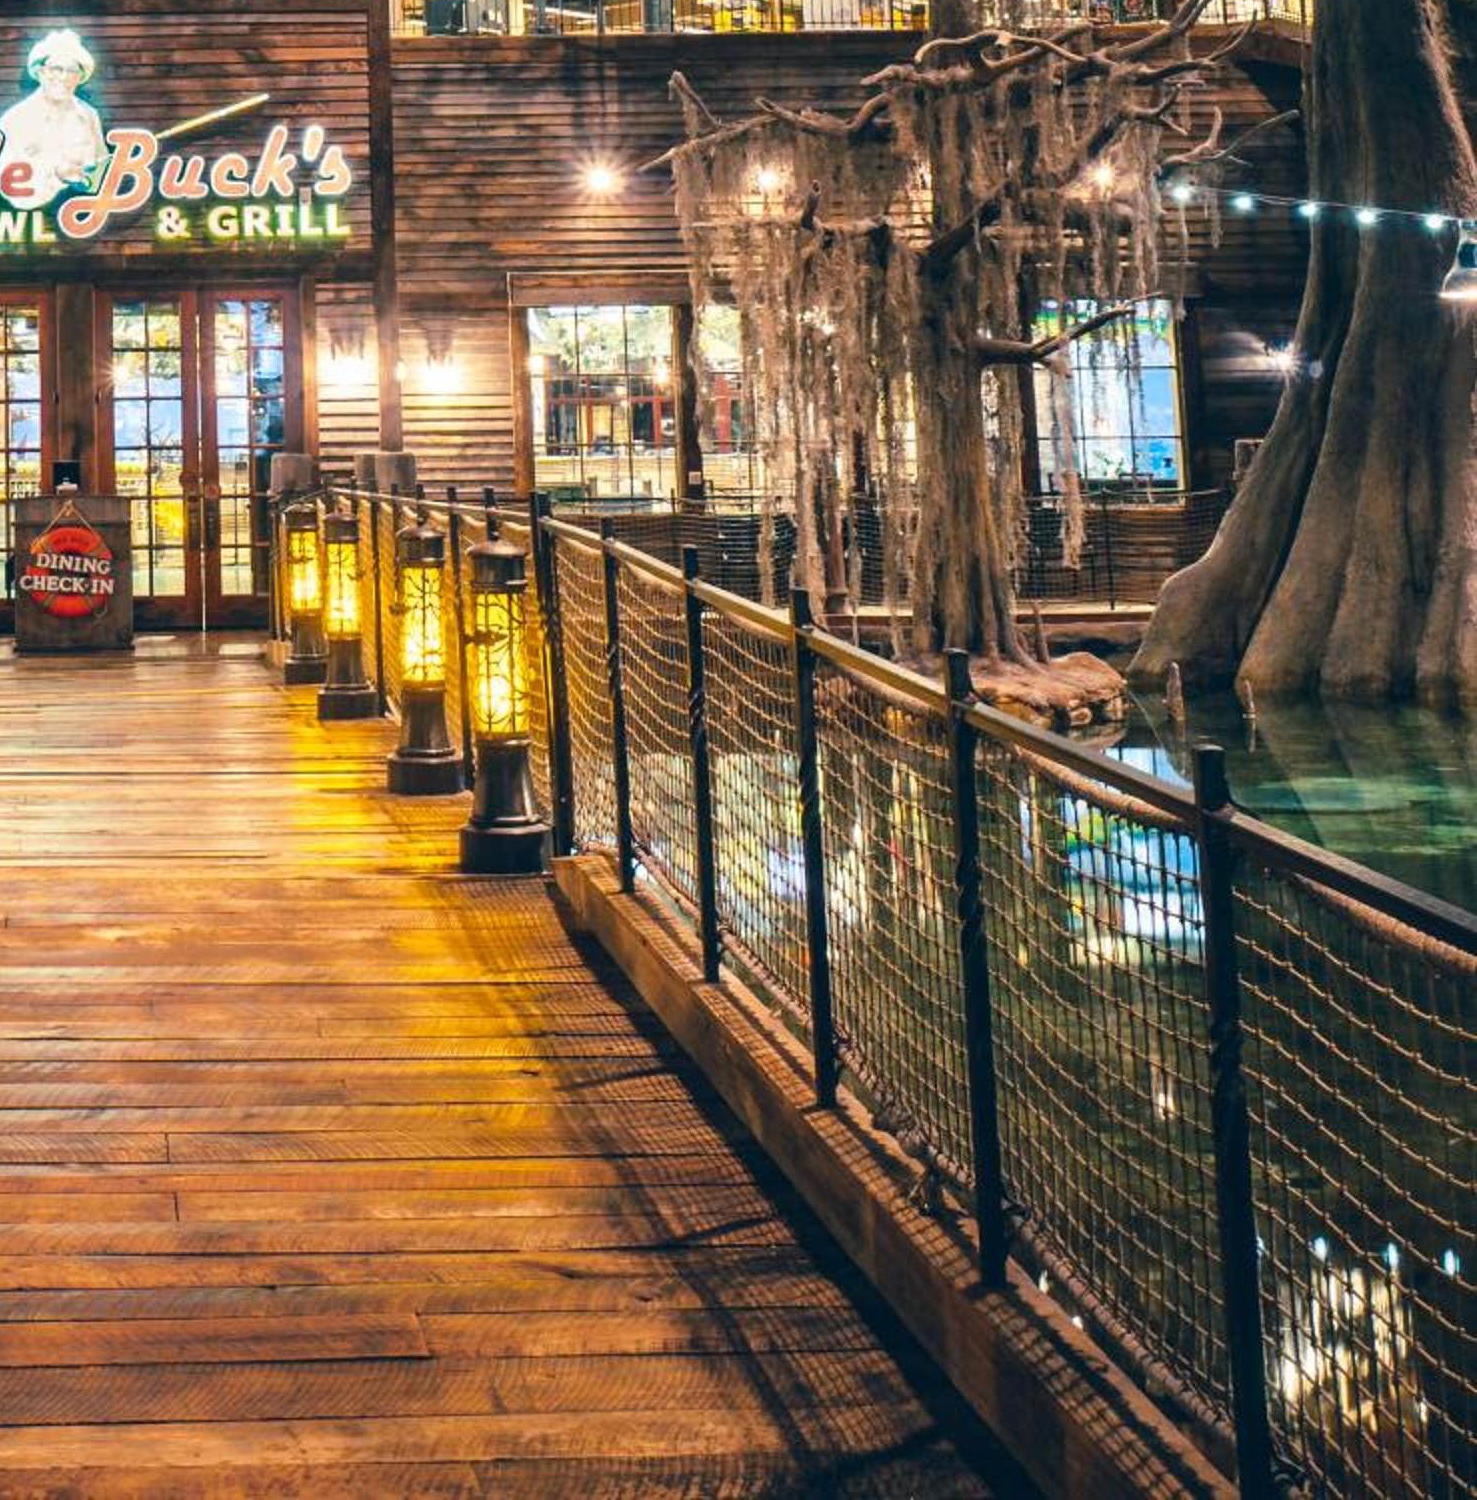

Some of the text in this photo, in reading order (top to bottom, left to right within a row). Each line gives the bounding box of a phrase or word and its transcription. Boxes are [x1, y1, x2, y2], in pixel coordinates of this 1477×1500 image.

[57, 125, 352, 238] Buck's
[155, 204, 191, 238] &
[207, 202, 351, 238] GRILL
[36, 552, 111, 575] DINING
